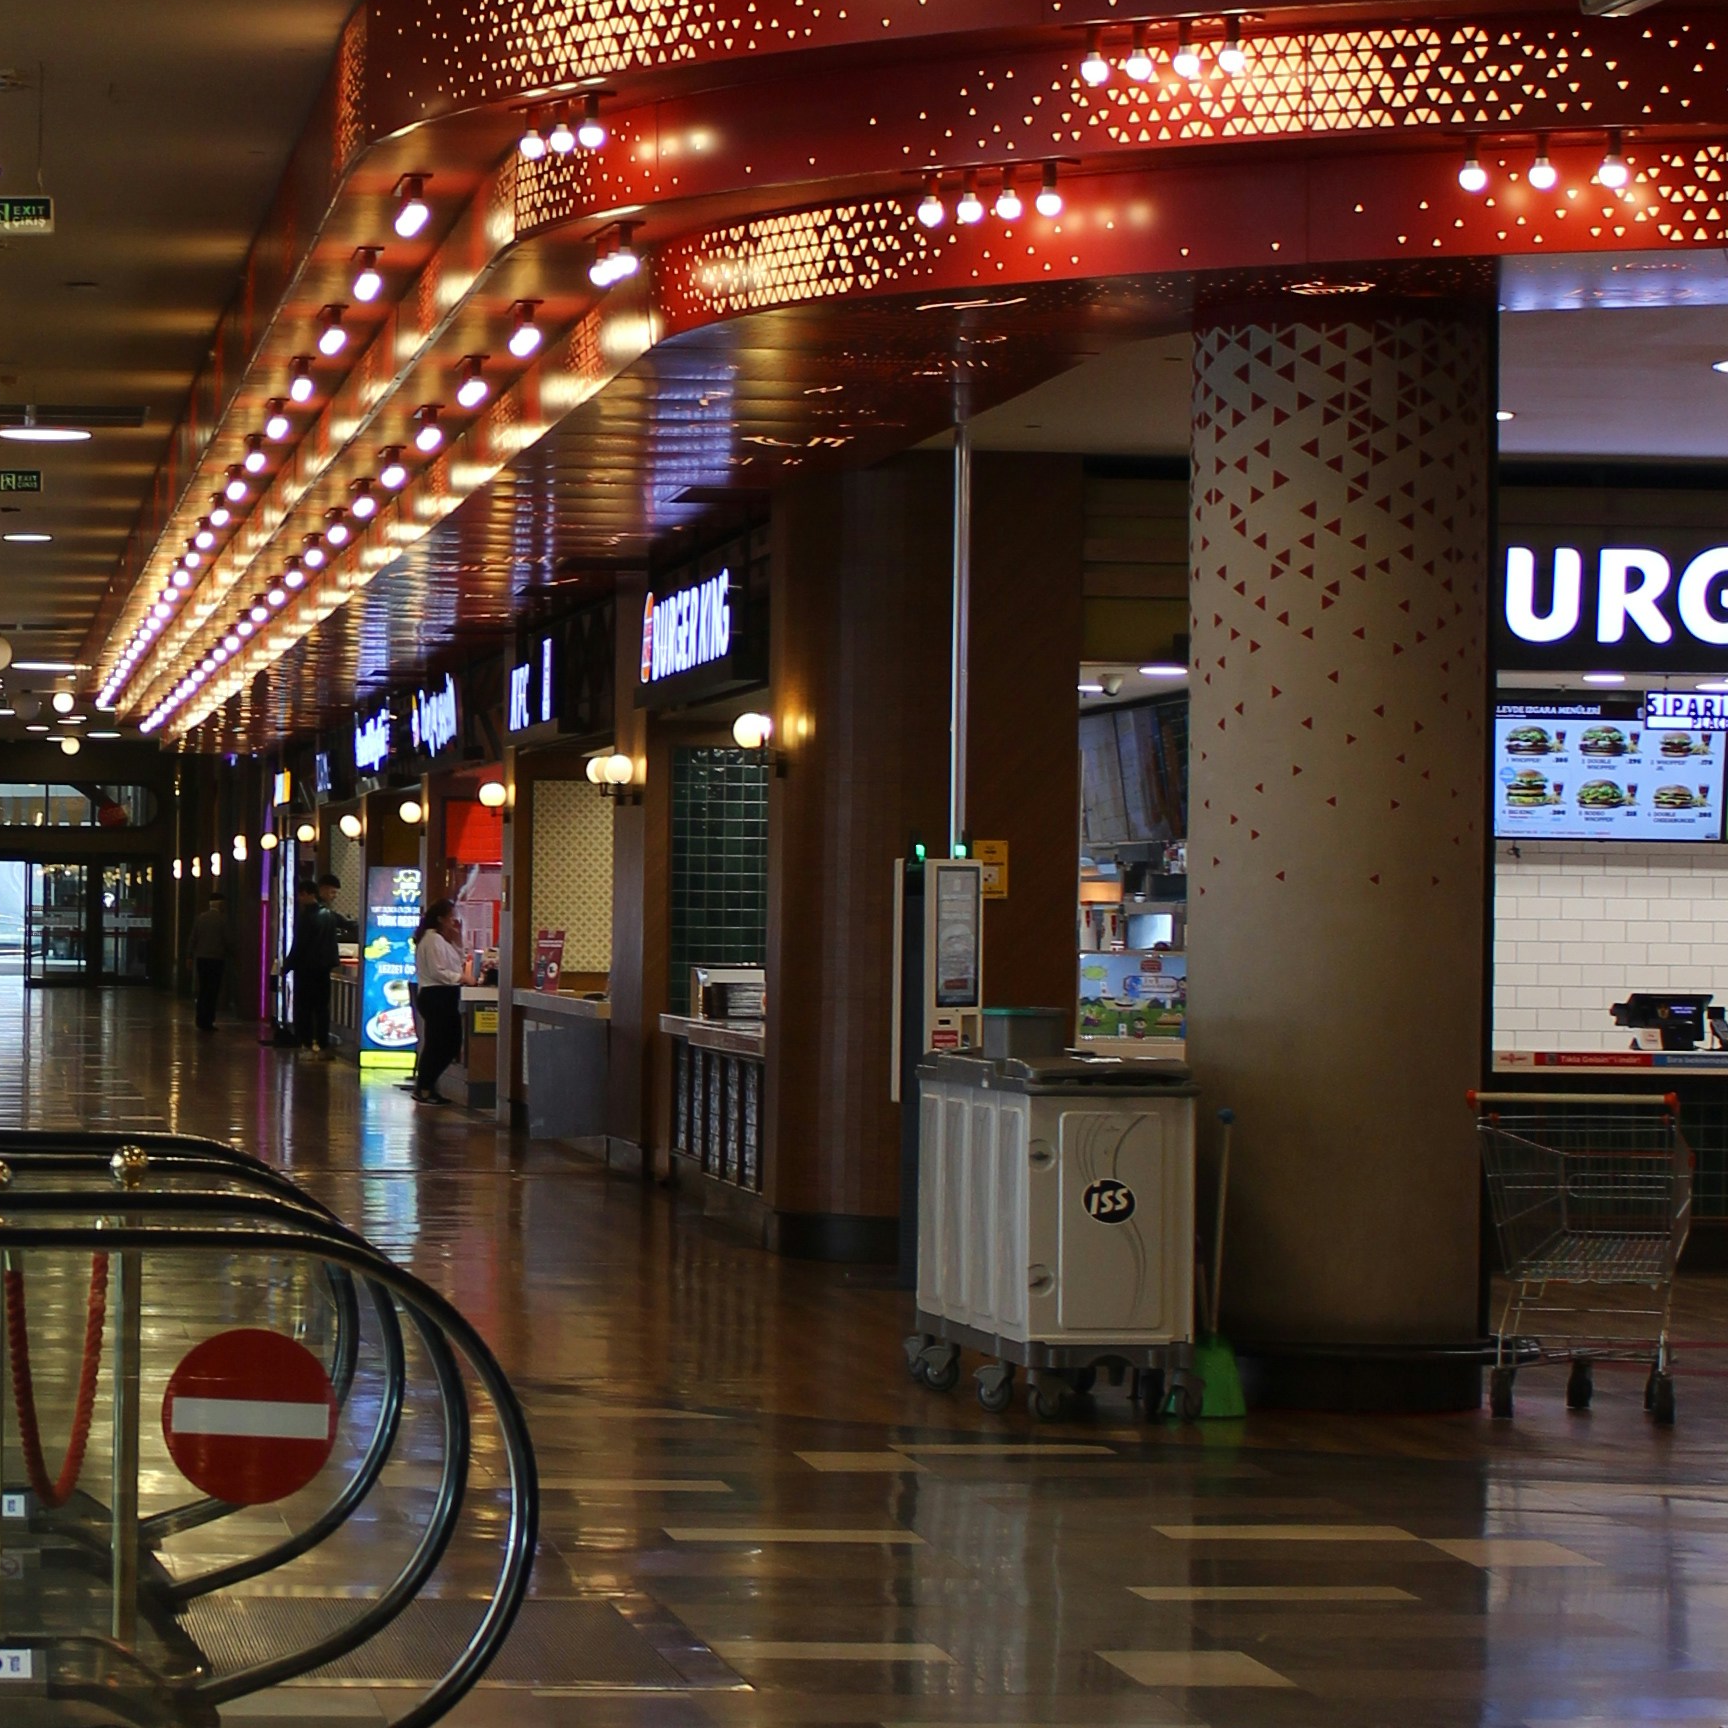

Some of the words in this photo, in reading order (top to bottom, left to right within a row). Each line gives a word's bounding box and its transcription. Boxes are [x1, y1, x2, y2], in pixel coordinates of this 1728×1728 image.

[13, 206, 45, 215] EXIT
[652, 586, 699, 682] BURGER
[697, 567, 730, 666] KING
